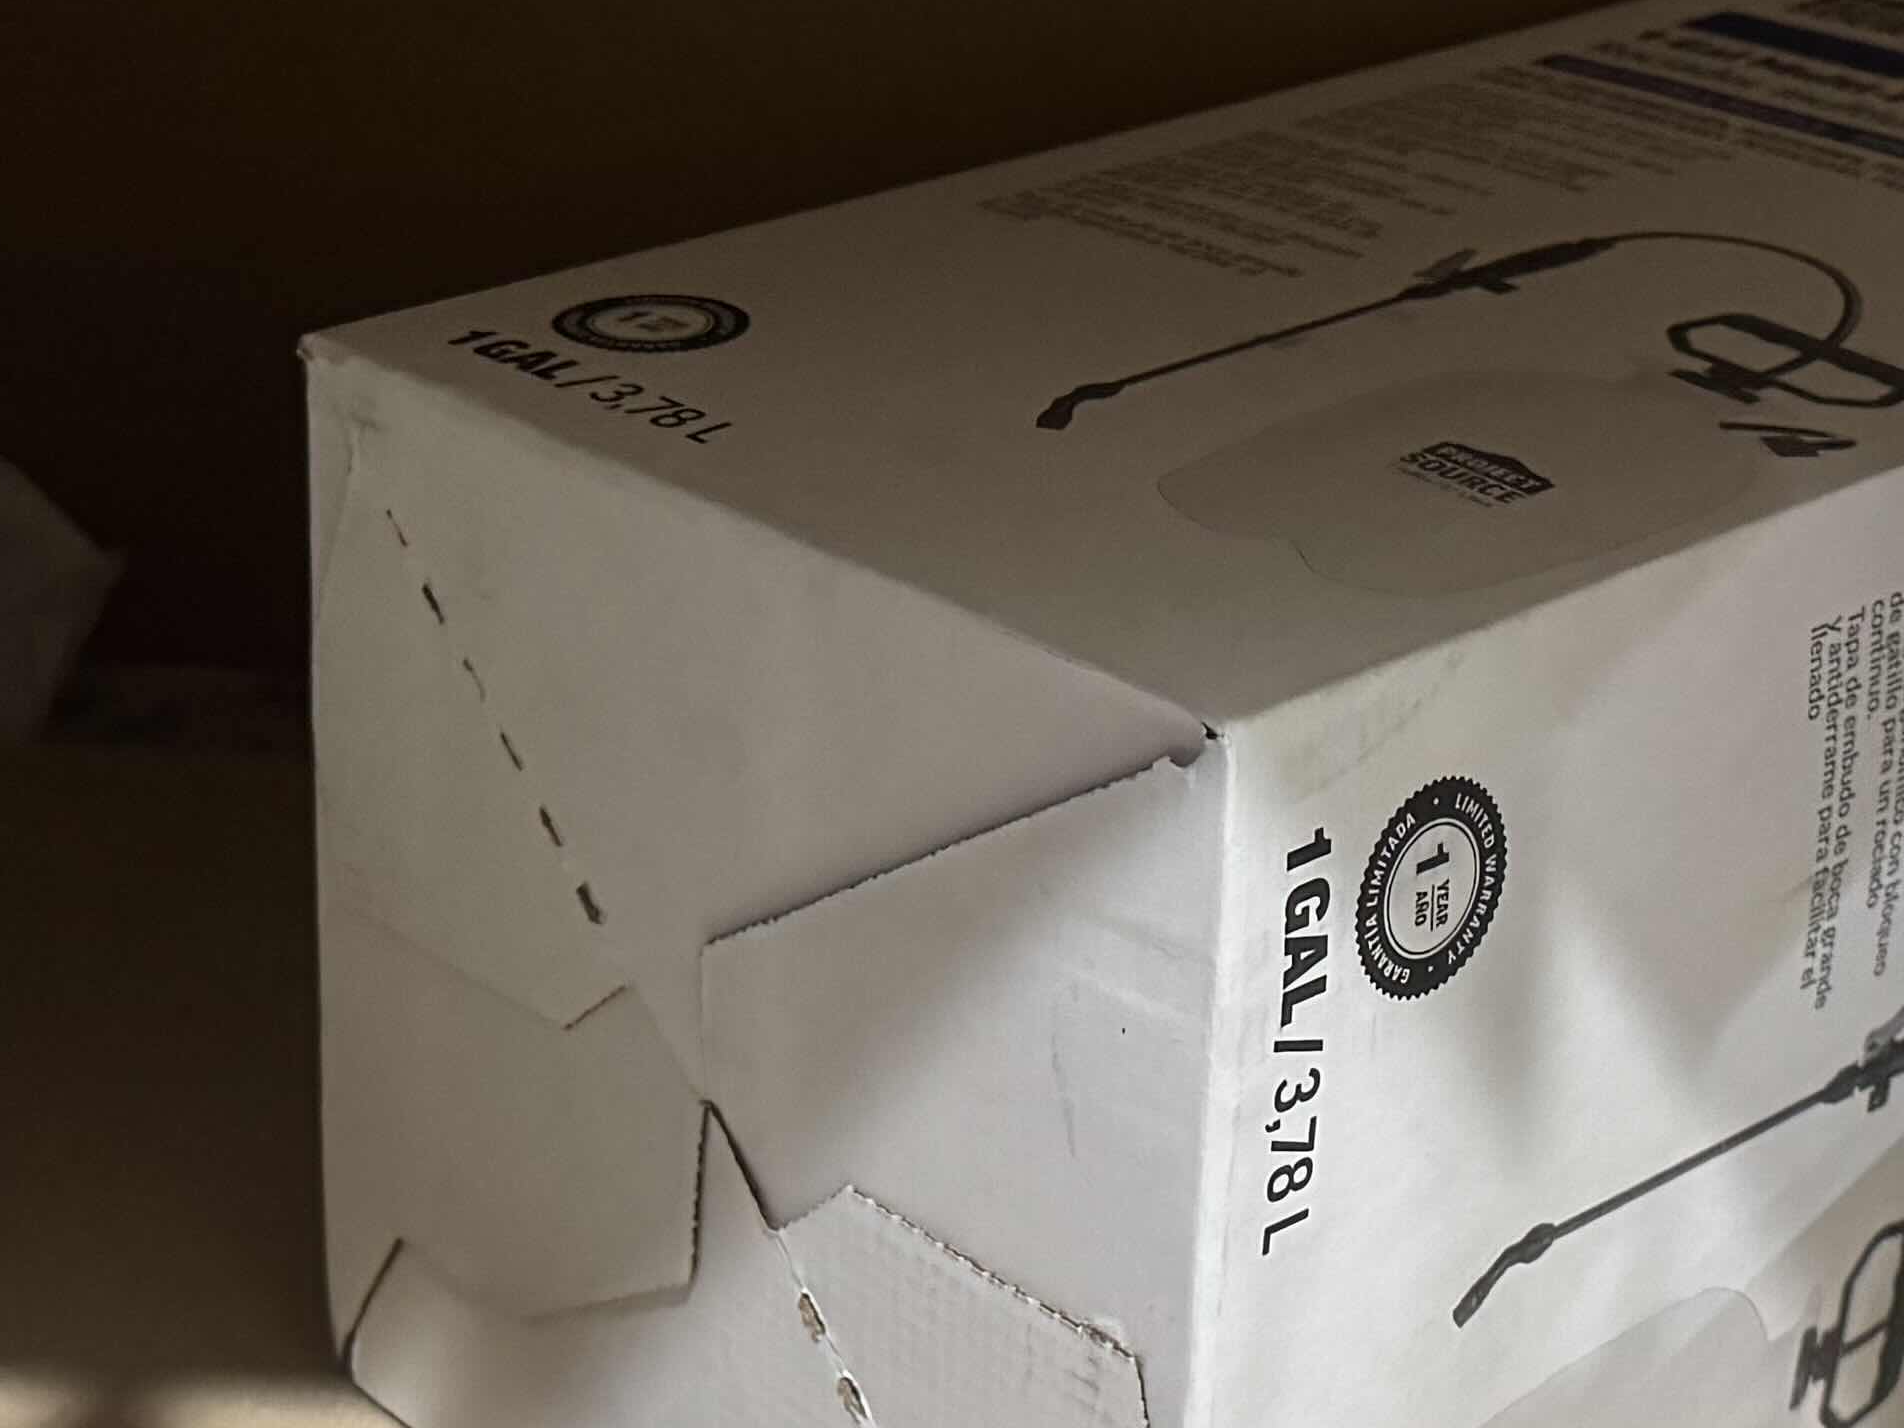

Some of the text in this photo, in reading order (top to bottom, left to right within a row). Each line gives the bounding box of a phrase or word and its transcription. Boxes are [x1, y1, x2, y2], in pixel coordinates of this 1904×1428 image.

[448, 330, 496, 345] 1
[474, 339, 580, 380] GAL
[589, 383, 706, 428] 3,78
[686, 422, 732, 443] L
[1396, 452, 1529, 504] SOURCE
[1803, 619, 1829, 725] llenado
[1864, 594, 1890, 723] continuo.
[1881, 625, 1904, 714] gatillo
[1877, 714, 1898, 777] para
[1798, 612, 1848, 993] y antiderrame para facilitar el
[1812, 604, 1865, 1013] Tapa de embudo de boca grande
[1874, 776, 1893, 816] un
[1365, 811, 1417, 910] LIMITADA
[1416, 842, 1450, 876] 1
[1446, 791, 1496, 964] LIMITED WARRANTY
[1864, 815, 1889, 912] rociado
[1885, 826, 1904, 878] con
[1413, 886, 1430, 929] AÑO
[1434, 878, 1450, 929] YEAR
[1870, 875, 1901, 981] bloqueo
[1261, 827, 1332, 1258] 1 GAL / 3,78 L
